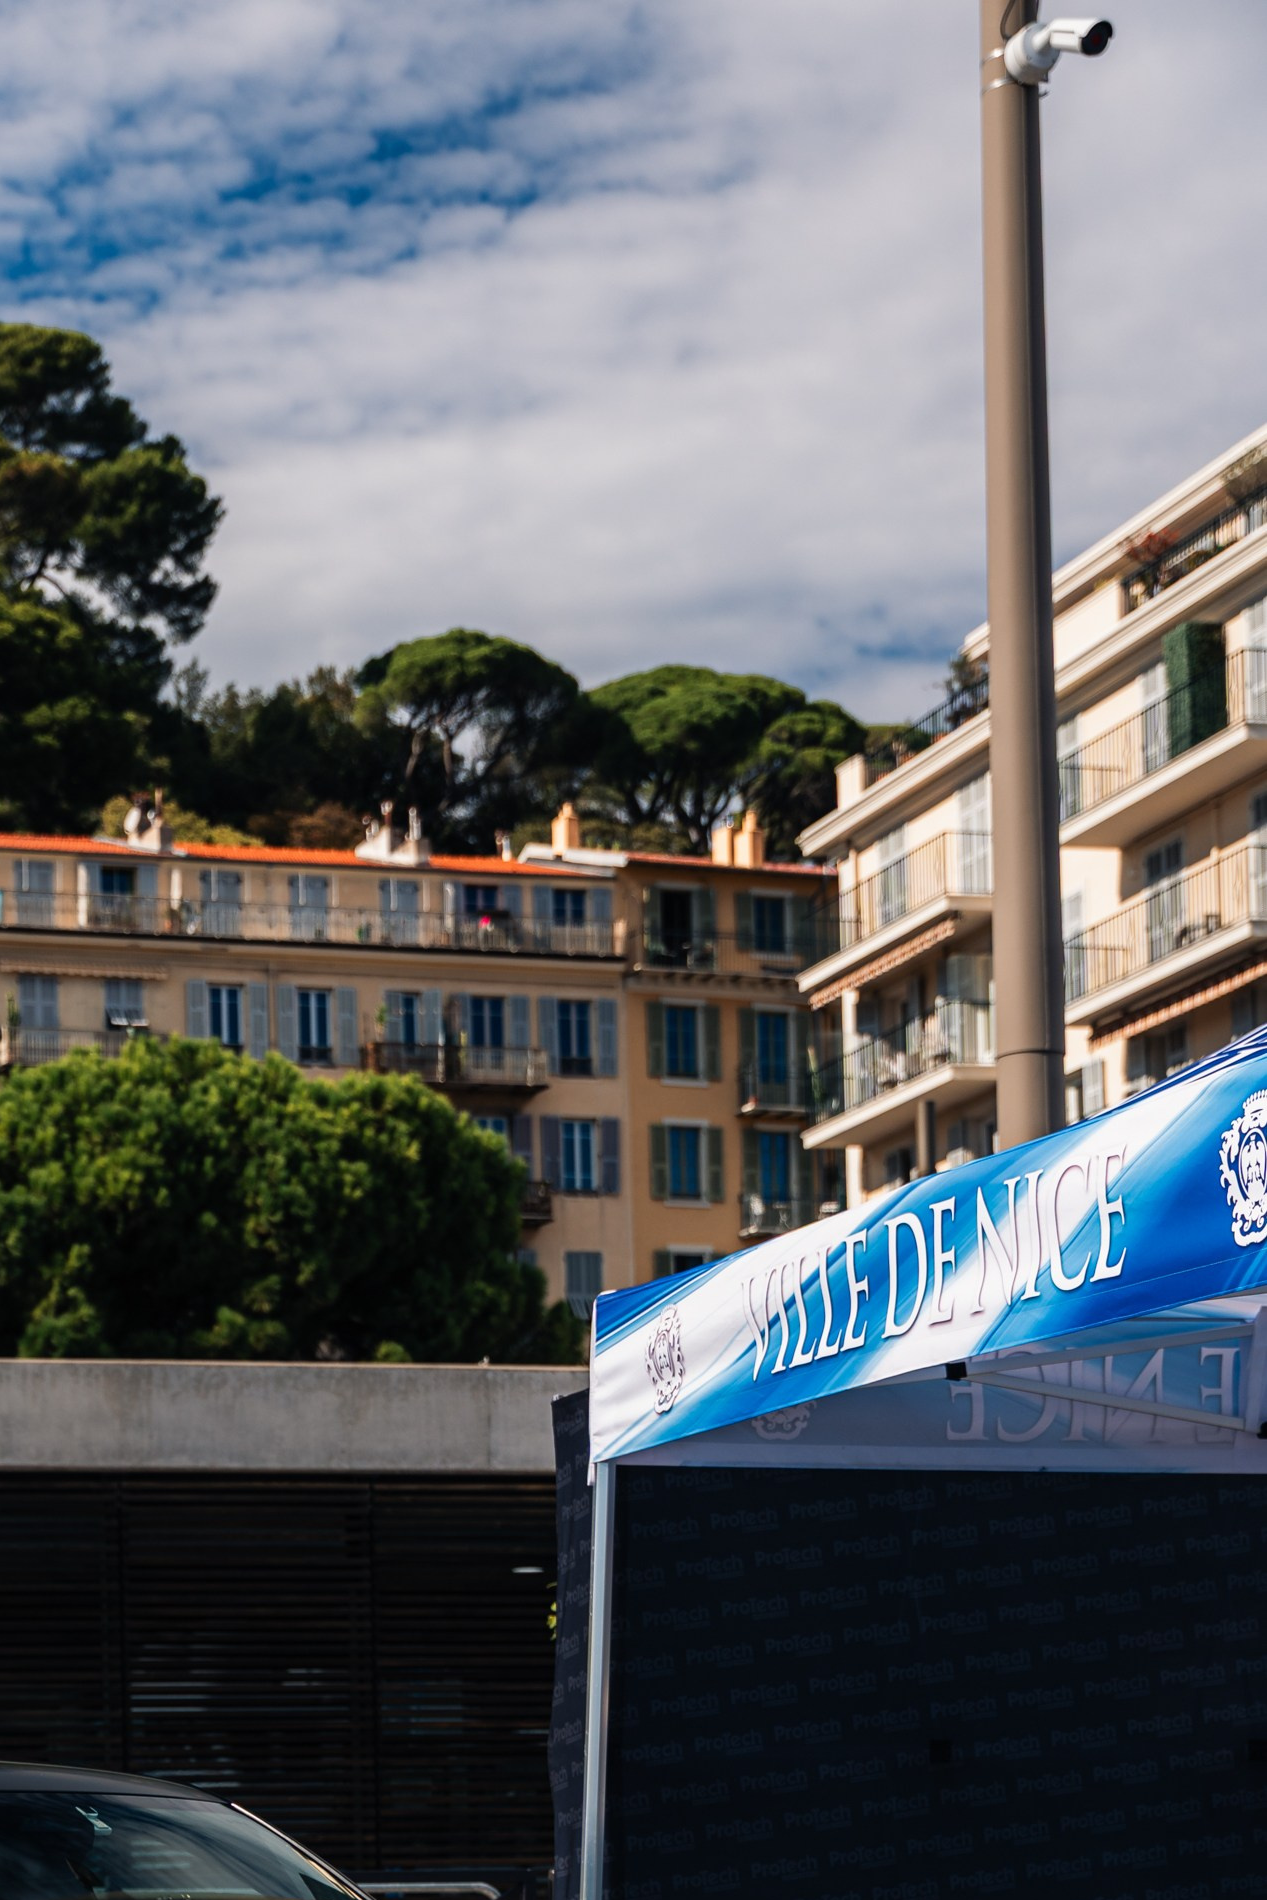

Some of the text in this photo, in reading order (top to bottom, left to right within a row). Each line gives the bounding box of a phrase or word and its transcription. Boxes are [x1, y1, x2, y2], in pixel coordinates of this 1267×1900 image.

[740, 1143, 1128, 1382] VILLE DE NICE
